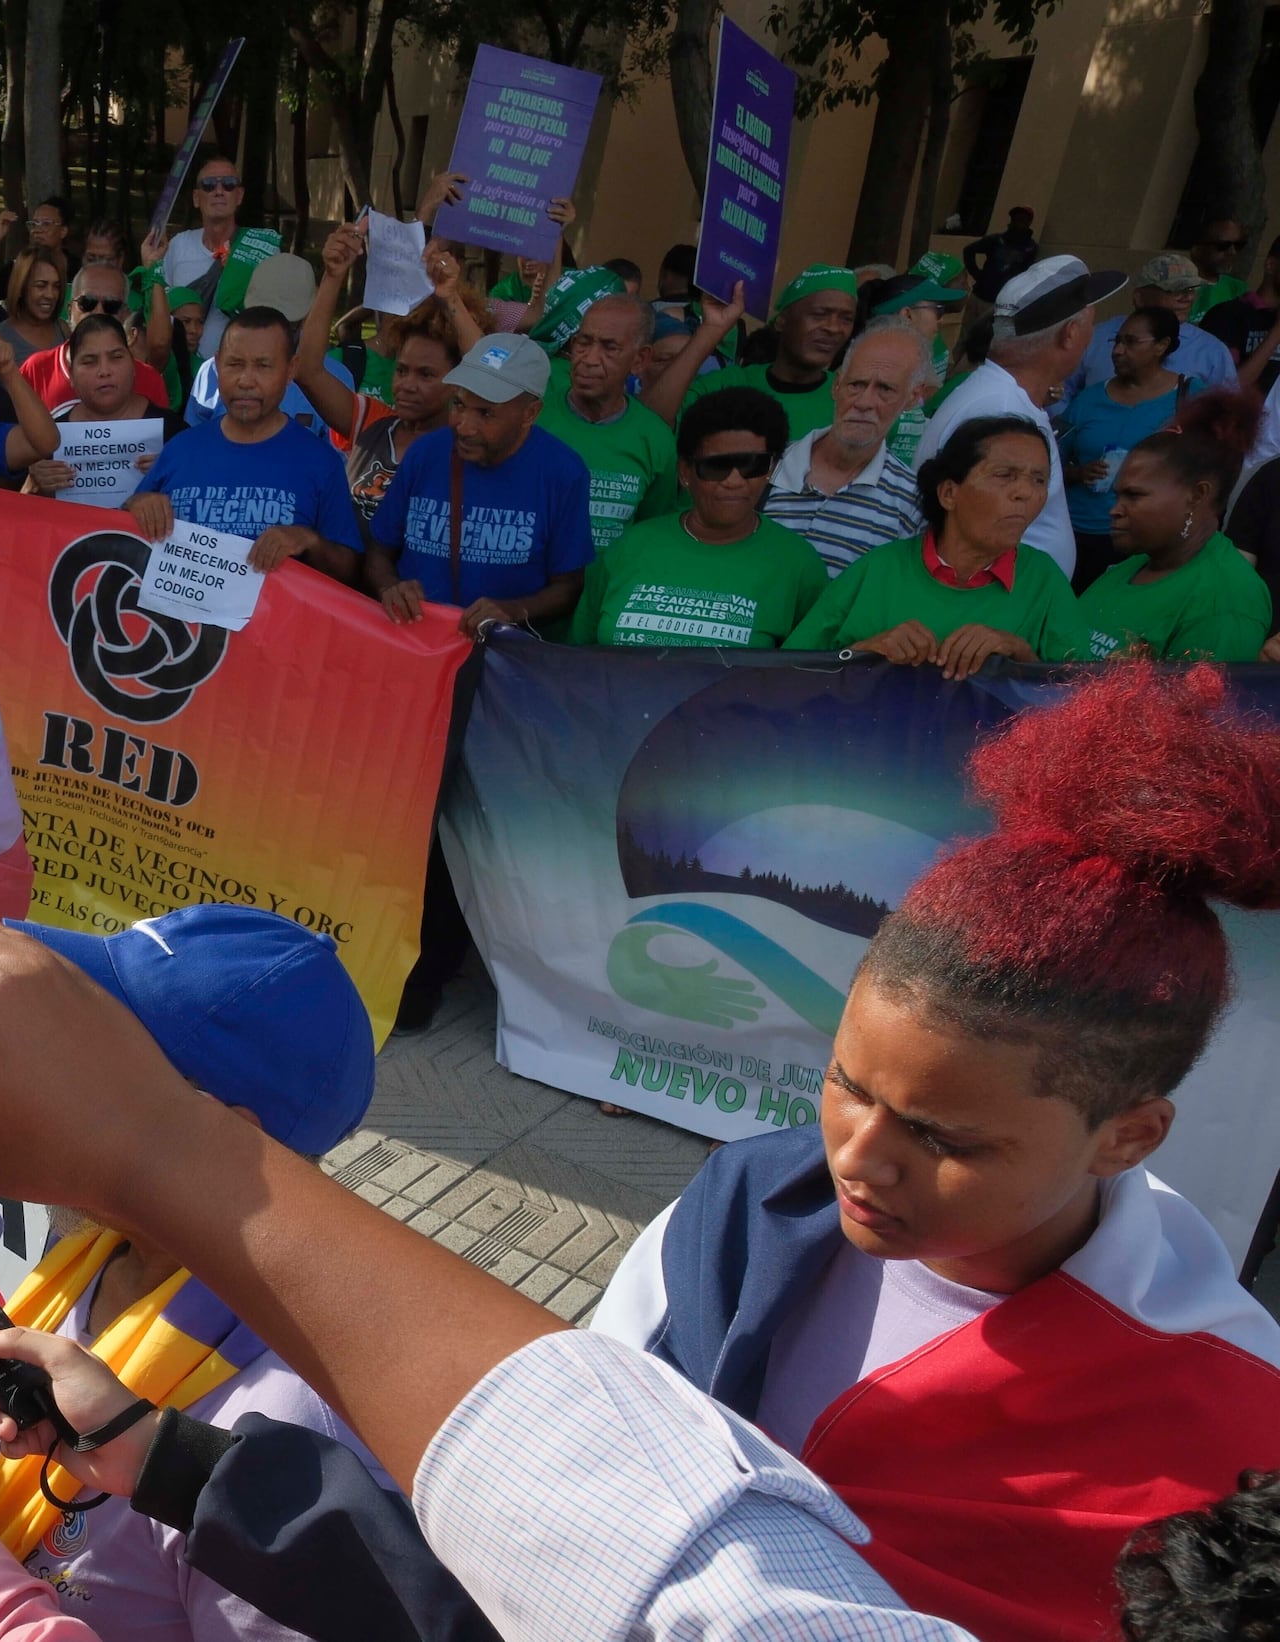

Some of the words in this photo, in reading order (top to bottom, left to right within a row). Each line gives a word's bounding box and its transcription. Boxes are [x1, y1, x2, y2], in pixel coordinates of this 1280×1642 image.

[499, 88, 564, 117] APOYAREMOS
[484, 102, 500, 119] UN
[501, 108, 538, 131] CÓDIGO
[538, 120, 567, 137] PENAL
[743, 108, 772, 150] ABORTO
[484, 121, 514, 135] para
[534, 132, 562, 149] pero
[722, 121, 759, 164] inseguro
[488, 140, 503, 154] NO
[508, 143, 531, 162] UNO
[531, 148, 552, 167] QUE
[487, 163, 538, 189] PROMUEVA
[716, 143, 740, 177] ABORTO
[752, 168, 781, 202] CAUSALES
[483, 185, 535, 209] agresión
[737, 183, 758, 208] para
[468, 197, 499, 219] NIÑOS
[506, 207, 537, 227] NIÑAS
[721, 198, 746, 233] SALVAR
[746, 215, 768, 244] VIDAS
[84, 428, 111, 439] NOS
[64, 442, 146, 456] MERECEMOS
[86, 460, 131, 471] MEJOR
[171, 486, 201, 500] RED
[204, 486, 229, 500] DE
[231, 486, 296, 505] JUNTAS
[195, 499, 296, 525] VECINOS
[409, 497, 438, 515] RED
[466, 506, 537, 527] JUNTAS
[189, 532, 218, 549] NOS
[163, 542, 248, 576] MERECEMOS
[154, 578, 205, 602] CODIGO
[158, 560, 177, 575] UN
[179, 567, 225, 590] MEJOR
[628, 592, 755, 619] #LASCAUSALESVAN
[618, 614, 631, 626] EN
[637, 617, 650, 630] EL
[657, 618, 704, 634] CÓDIGO
[712, 626, 749, 645] PENAL
[37, 710, 201, 808] RED
[11, 765, 30, 779] DE
[32, 771, 89, 793] JUNTAS
[91, 785, 112, 799] DE
[113, 792, 172, 822] VECINOS
[172, 816, 184, 827] Y
[185, 820, 216, 840] OCB
[33, 784, 48, 793] DE
[48, 786, 61, 795] LA
[61, 788, 111, 811] PROVINCIA
[111, 804, 141, 821] SANTO
[140, 816, 182, 838] DOMINGO
[55, 798, 85, 815] Social,
[89, 808, 129, 831] Inclusión
[22, 809, 80, 838] NTA
[88, 826, 125, 856] DE
[135, 843, 257, 905] VECINOS
[267, 892, 288, 912] Y
[23, 830, 103, 866] VINCIA
[109, 857, 190, 901] SANTO
[85, 872, 178, 918] JUVEC
[55, 896, 89, 921] LAS
[91, 911, 127, 933] CO
[587, 1016, 733, 1071] ASOCIACIÓN
[739, 1056, 771, 1082] DE
[609, 1047, 747, 1113] NUEVO
[754, 1085, 818, 1129] HO
